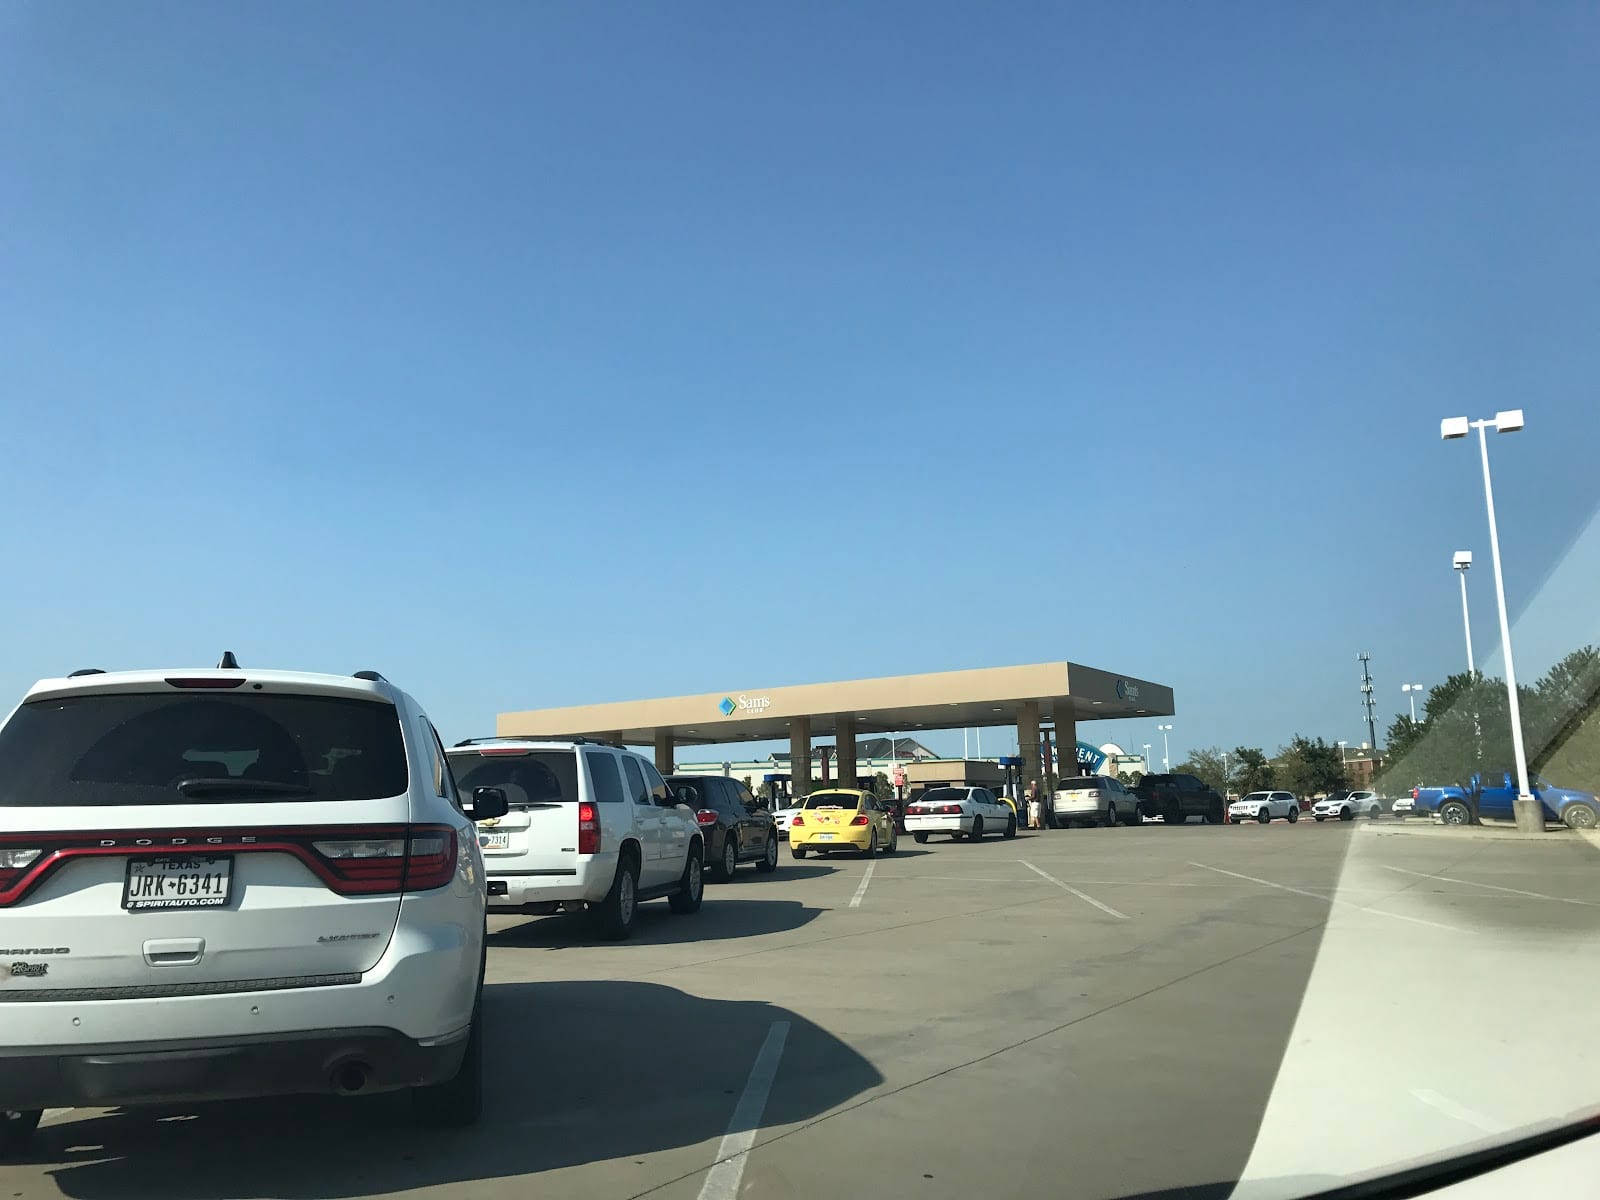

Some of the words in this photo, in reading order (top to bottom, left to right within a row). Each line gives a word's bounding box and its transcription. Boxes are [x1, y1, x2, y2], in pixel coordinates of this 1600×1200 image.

[739, 694, 770, 709] Sam's
[1075, 746, 1100, 764] ENT
[100, 836, 257, 847] DODGE
[161, 861, 201, 871] TEXAS
[136, 898, 223, 908] SPIRITAUTO.COM
